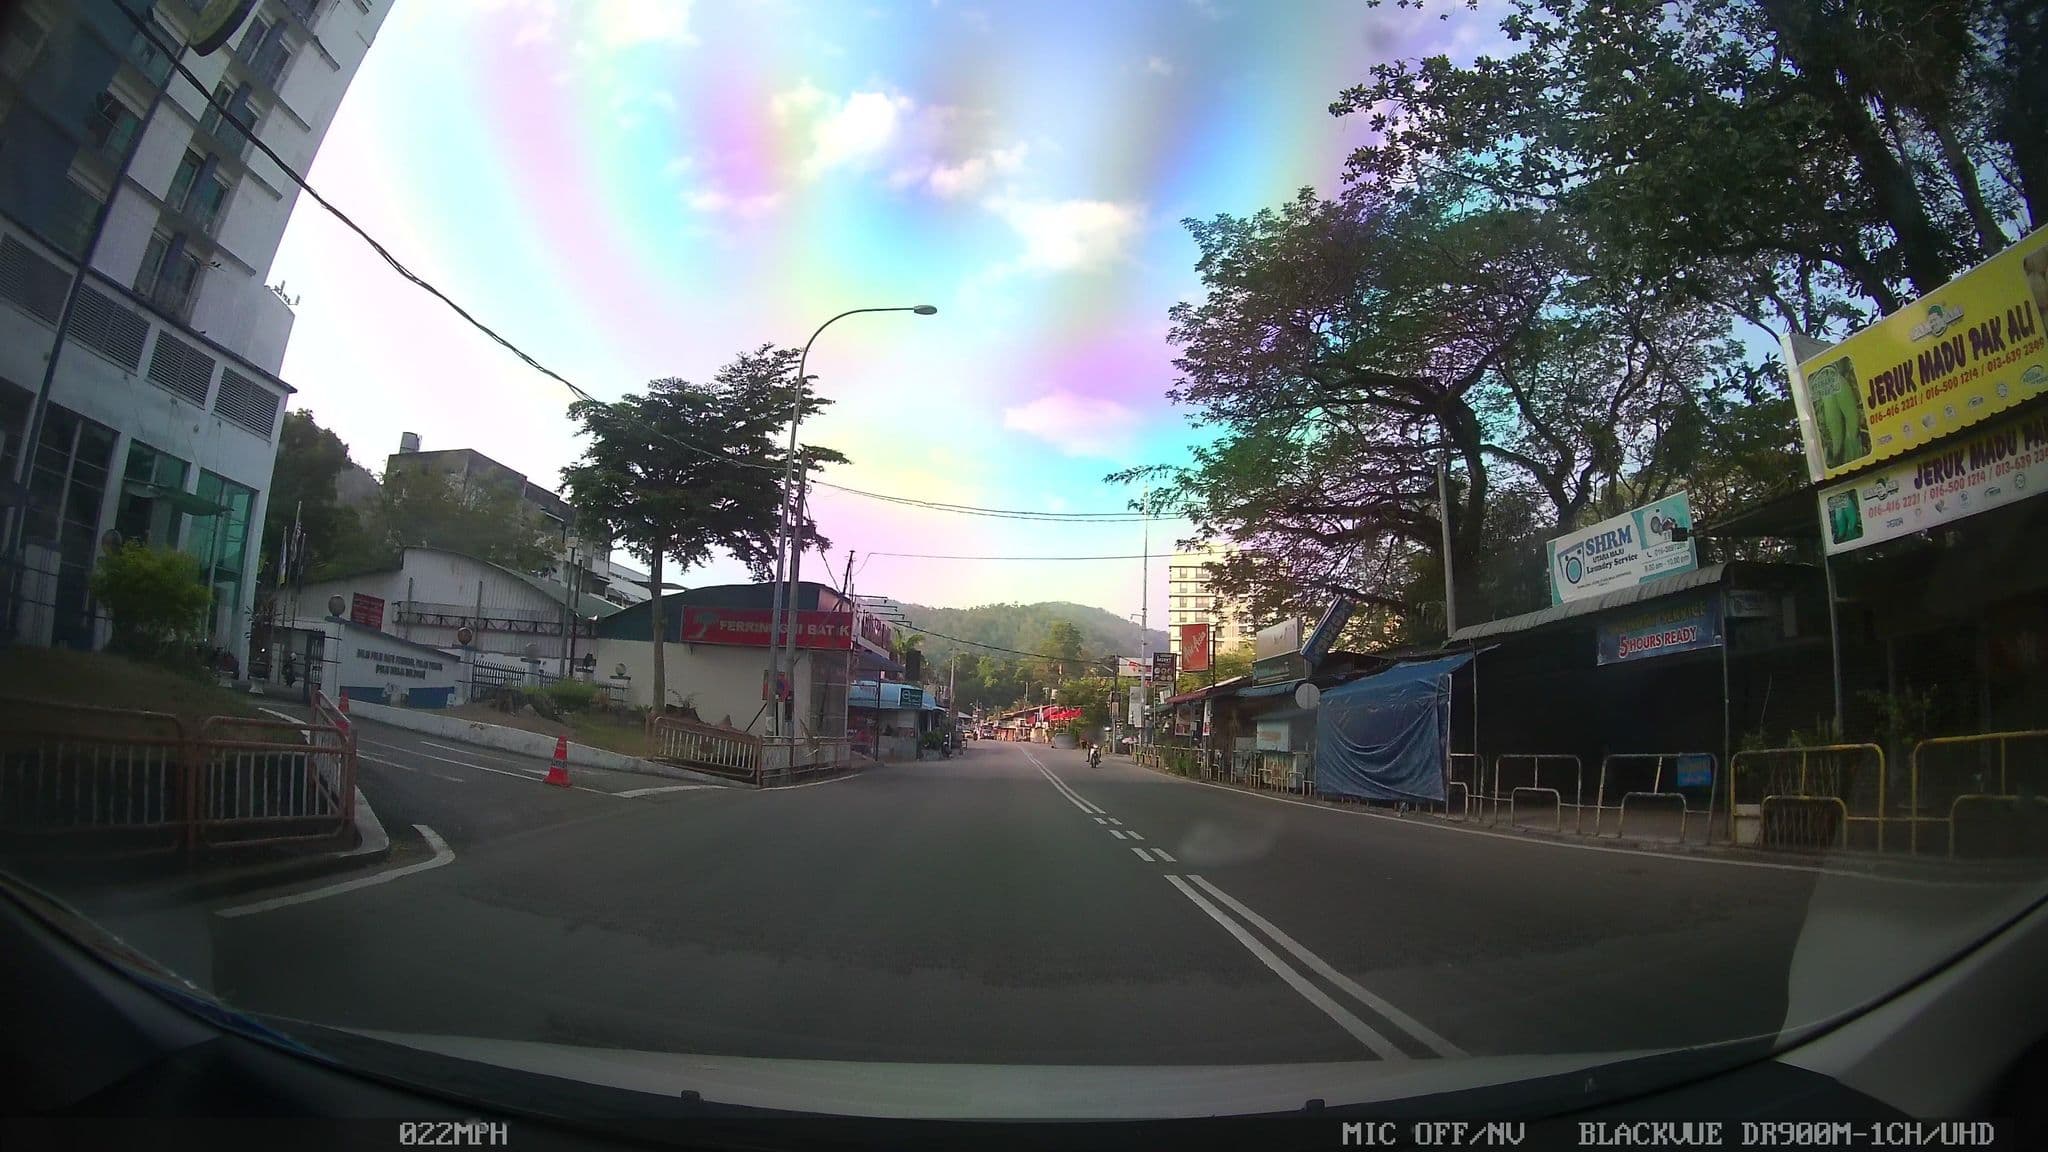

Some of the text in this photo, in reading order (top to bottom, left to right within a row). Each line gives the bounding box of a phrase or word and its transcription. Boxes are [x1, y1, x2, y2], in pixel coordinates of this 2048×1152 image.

[1867, 359, 1917, 409] JERUK
[1918, 334, 1967, 386] MADU
[1968, 316, 2006, 361] PAK
[2007, 300, 2036, 344] ALI
[1870, 404, 1899, 425] 016-416
[1901, 395, 1918, 411] 2221
[1925, 379, 1959, 400] 016-500
[1960, 368, 1979, 386] 1214
[1987, 348, 2021, 373] 013-639
[1914, 447, 1966, 490] JERUK
[1969, 428, 2018, 471] MADU
[1929, 479, 1965, 500] 016-500
[1584, 525, 1632, 556] SHRM
[1586, 553, 1638, 575] Laundry Service
[1619, 626, 1697, 659] 5 HOURS READY
